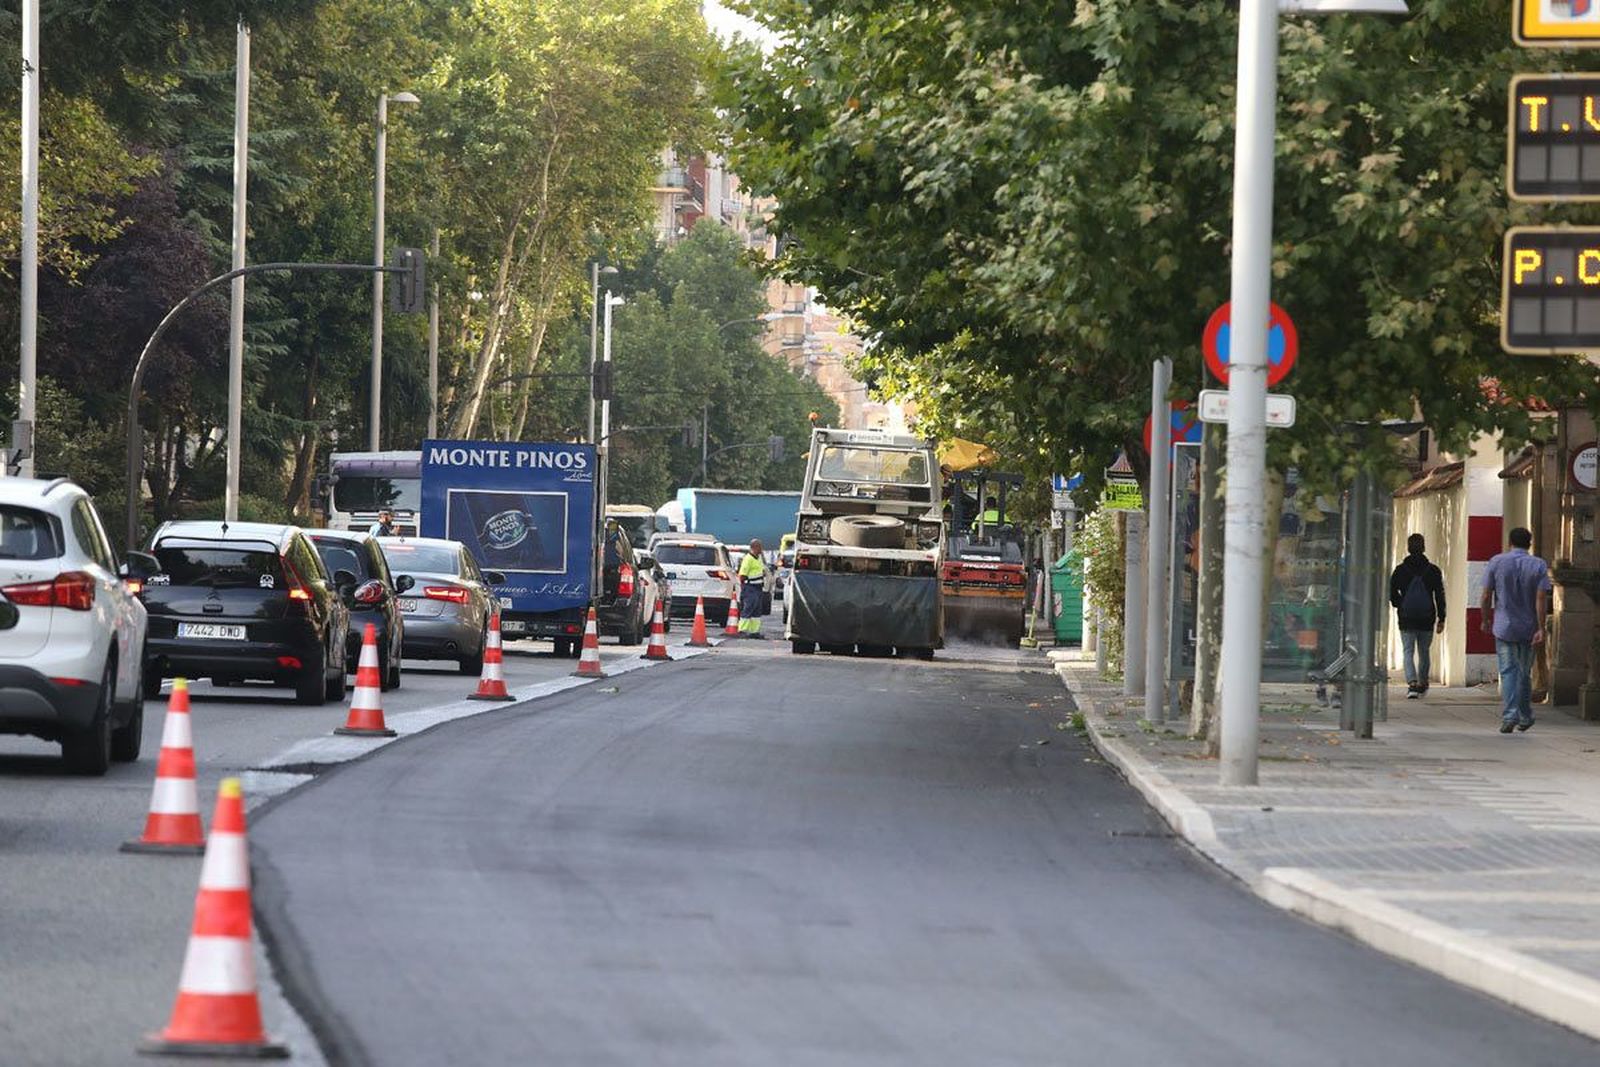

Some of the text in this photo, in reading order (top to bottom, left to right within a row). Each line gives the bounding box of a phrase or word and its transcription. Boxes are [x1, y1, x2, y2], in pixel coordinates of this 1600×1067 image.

[429, 447, 587, 470] MONTE PINOS
[489, 514, 517, 530] MONTE
[494, 521, 520, 535] PINOS
[186, 624, 214, 637] 7442
